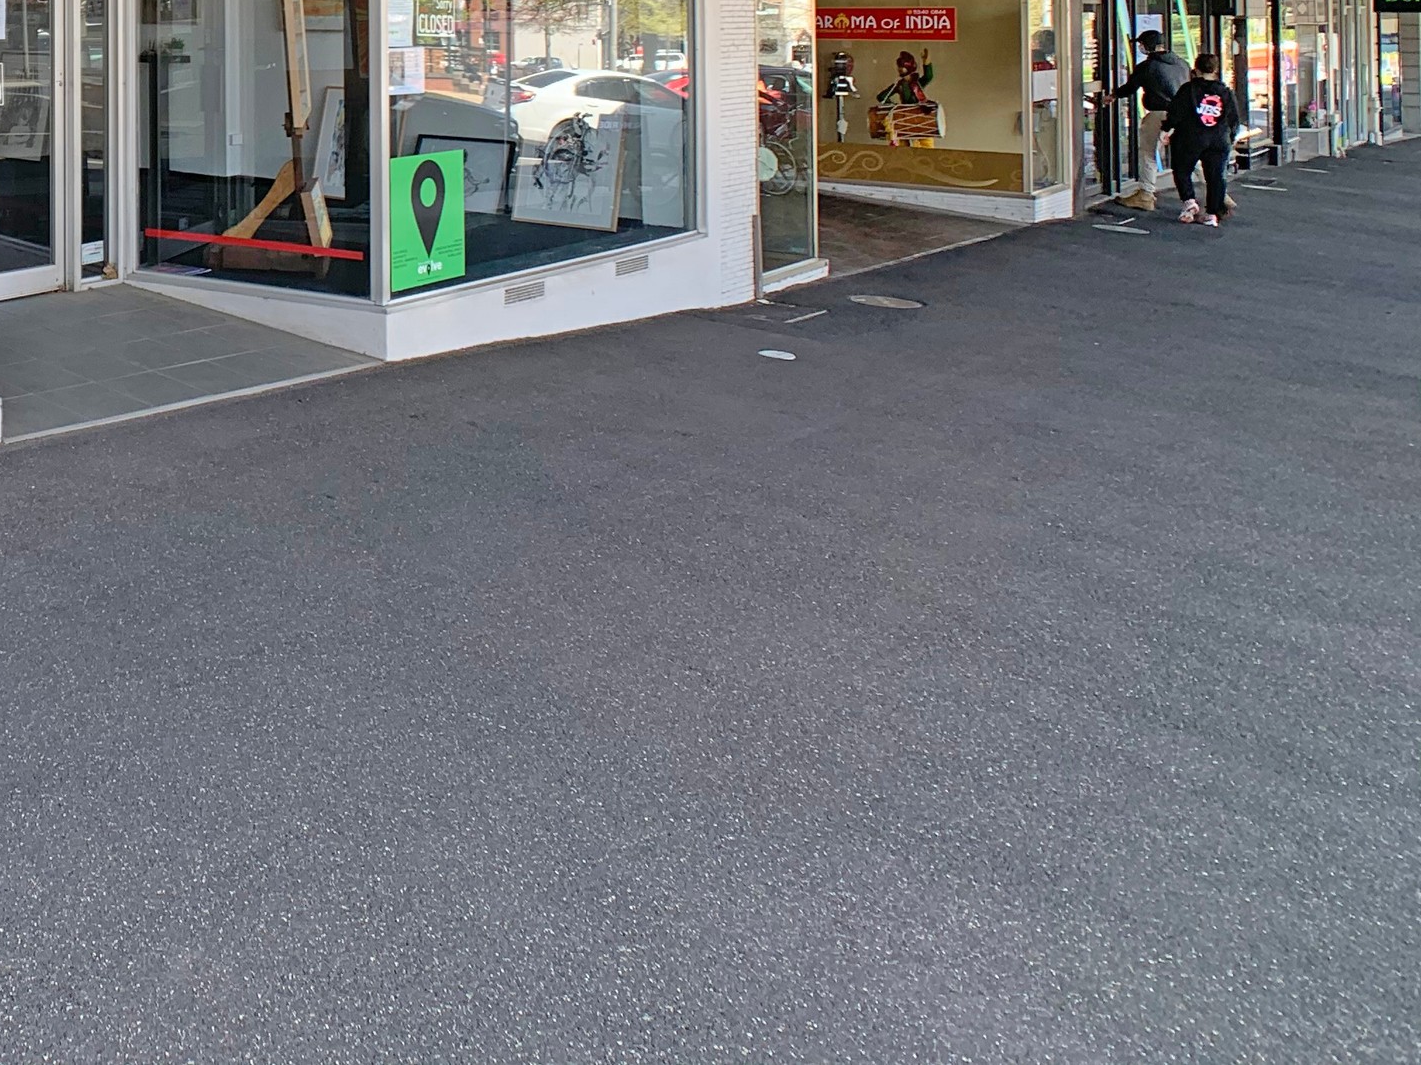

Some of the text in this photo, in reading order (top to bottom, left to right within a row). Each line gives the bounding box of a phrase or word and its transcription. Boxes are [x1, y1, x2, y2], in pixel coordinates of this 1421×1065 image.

[418, 14, 454, 34] CLOSED
[816, 12, 877, 29] AROMA
[905, 15, 951, 30] INDIA
